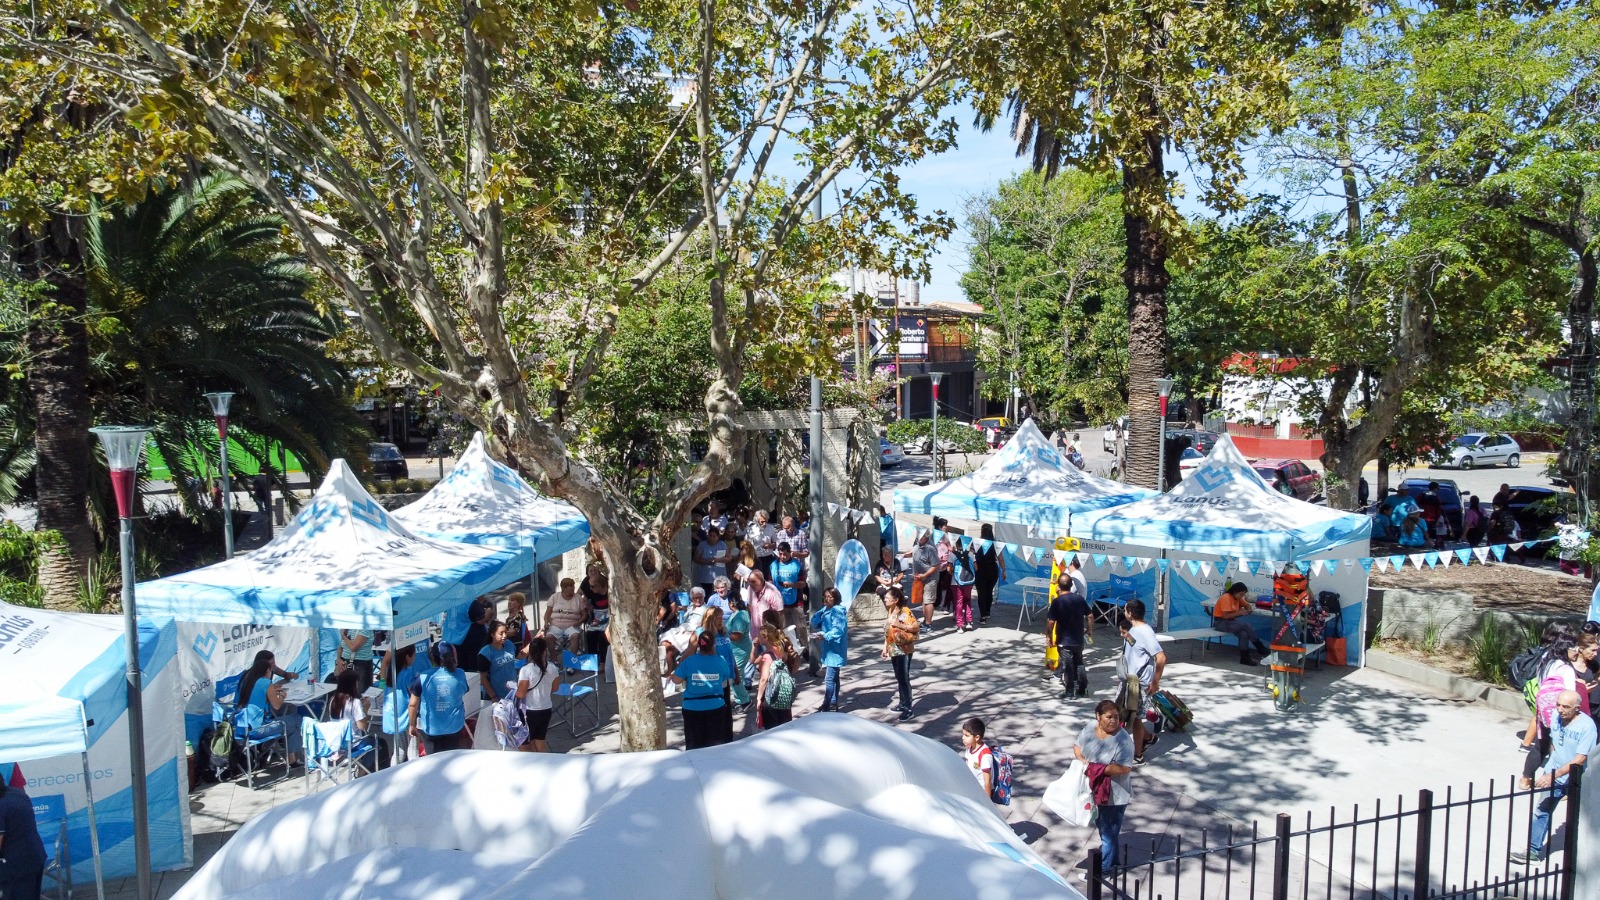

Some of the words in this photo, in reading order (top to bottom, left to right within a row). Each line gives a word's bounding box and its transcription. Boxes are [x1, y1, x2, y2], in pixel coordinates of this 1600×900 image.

[1173, 496, 1230, 507] Lanús
[1200, 577, 1211, 585] La
[0, 615, 35, 649] anús
[405, 626, 423, 639] Salud
[233, 635, 264, 654] GOBIERNO
[27, 768, 113, 788] erecemos
